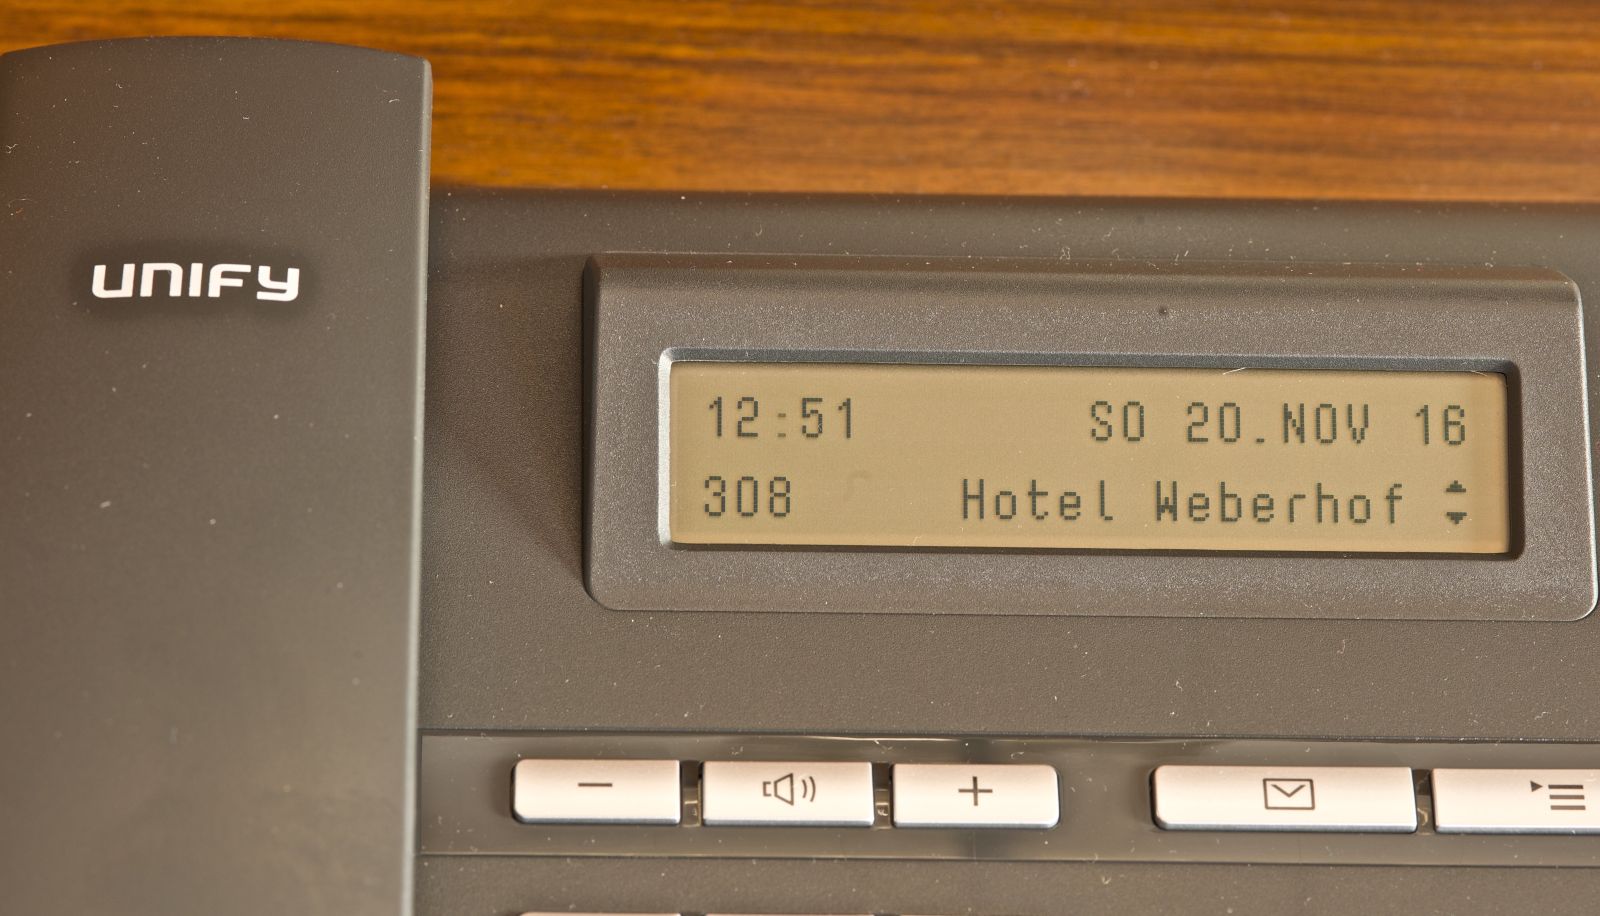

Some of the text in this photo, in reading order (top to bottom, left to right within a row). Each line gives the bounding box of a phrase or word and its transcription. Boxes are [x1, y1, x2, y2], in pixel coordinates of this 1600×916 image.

[709, 396, 1466, 446] 12:51 SO 20.NOV 16
[704, 475, 1403, 524] 308 Hotel Weberhof
